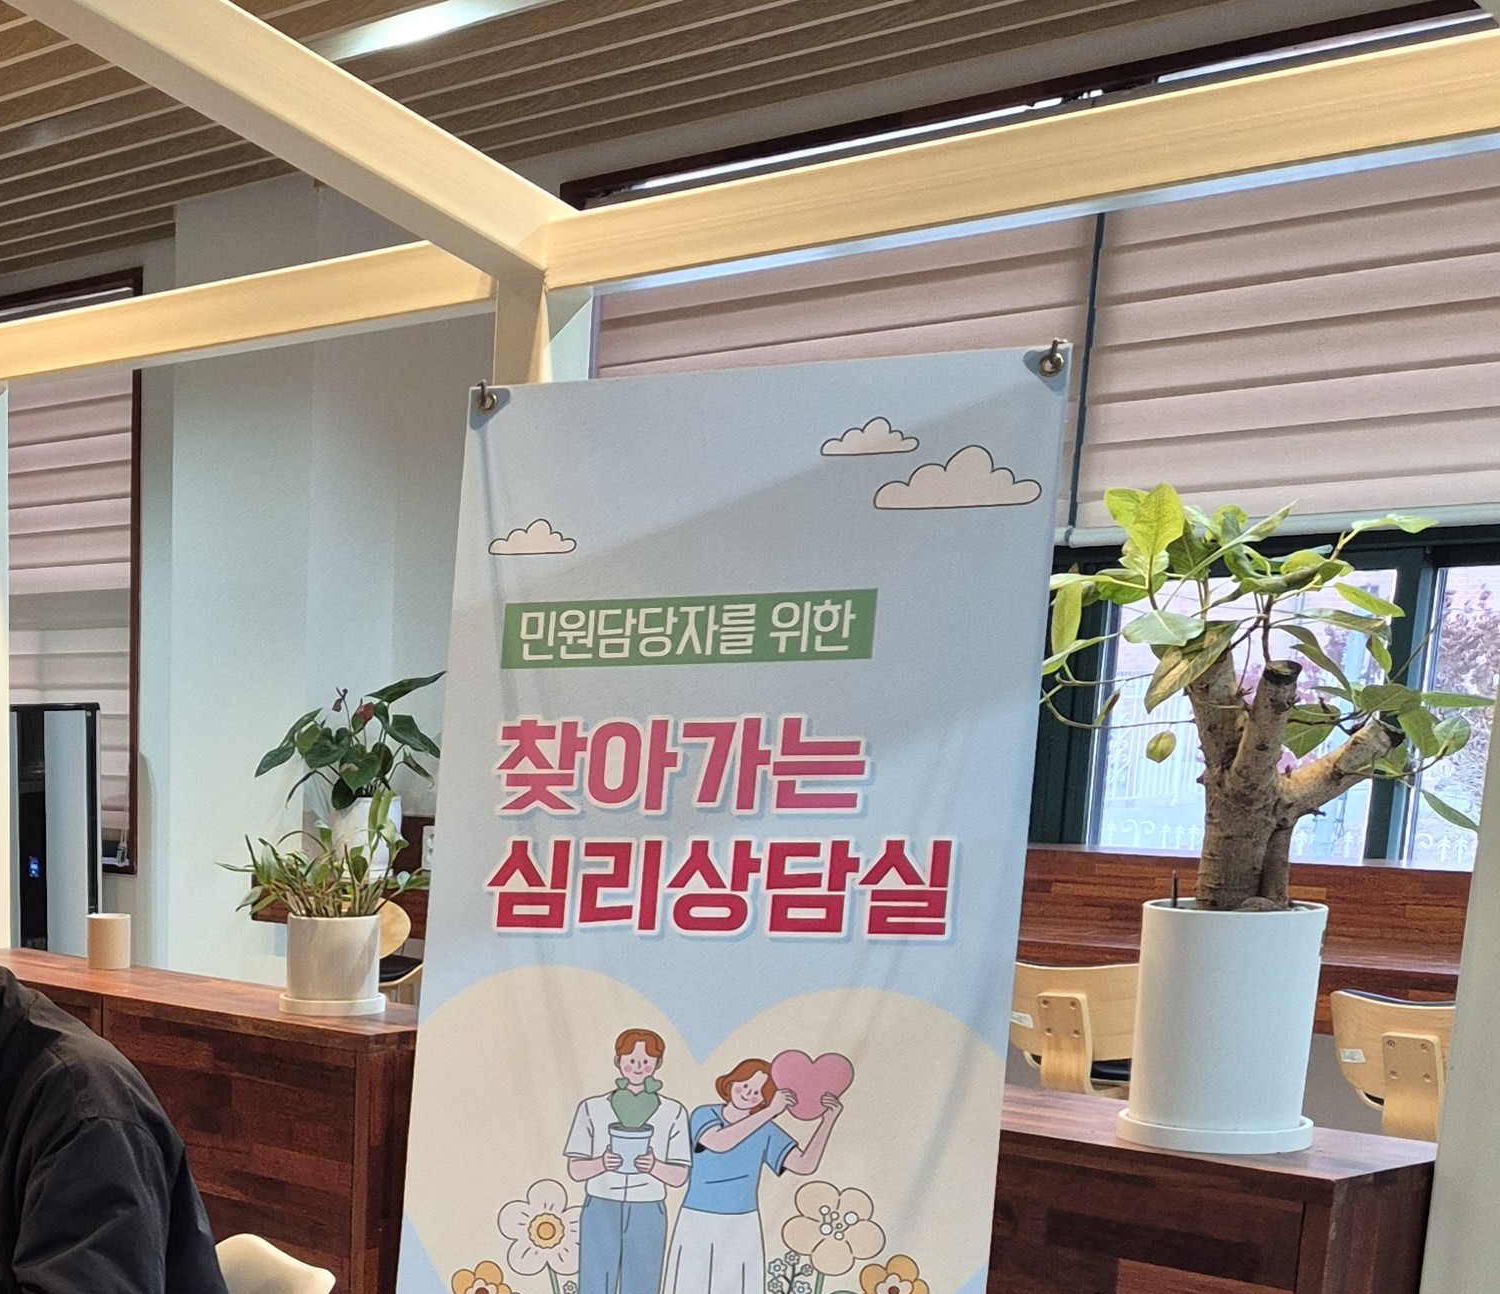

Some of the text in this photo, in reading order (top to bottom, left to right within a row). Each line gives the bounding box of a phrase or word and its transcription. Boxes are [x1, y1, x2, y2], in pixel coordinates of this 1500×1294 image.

[520, 600, 856, 662] 민원담당자를 위한
[496, 716, 867, 812] 찾아가는
[486, 839, 953, 936] 심리상담실
